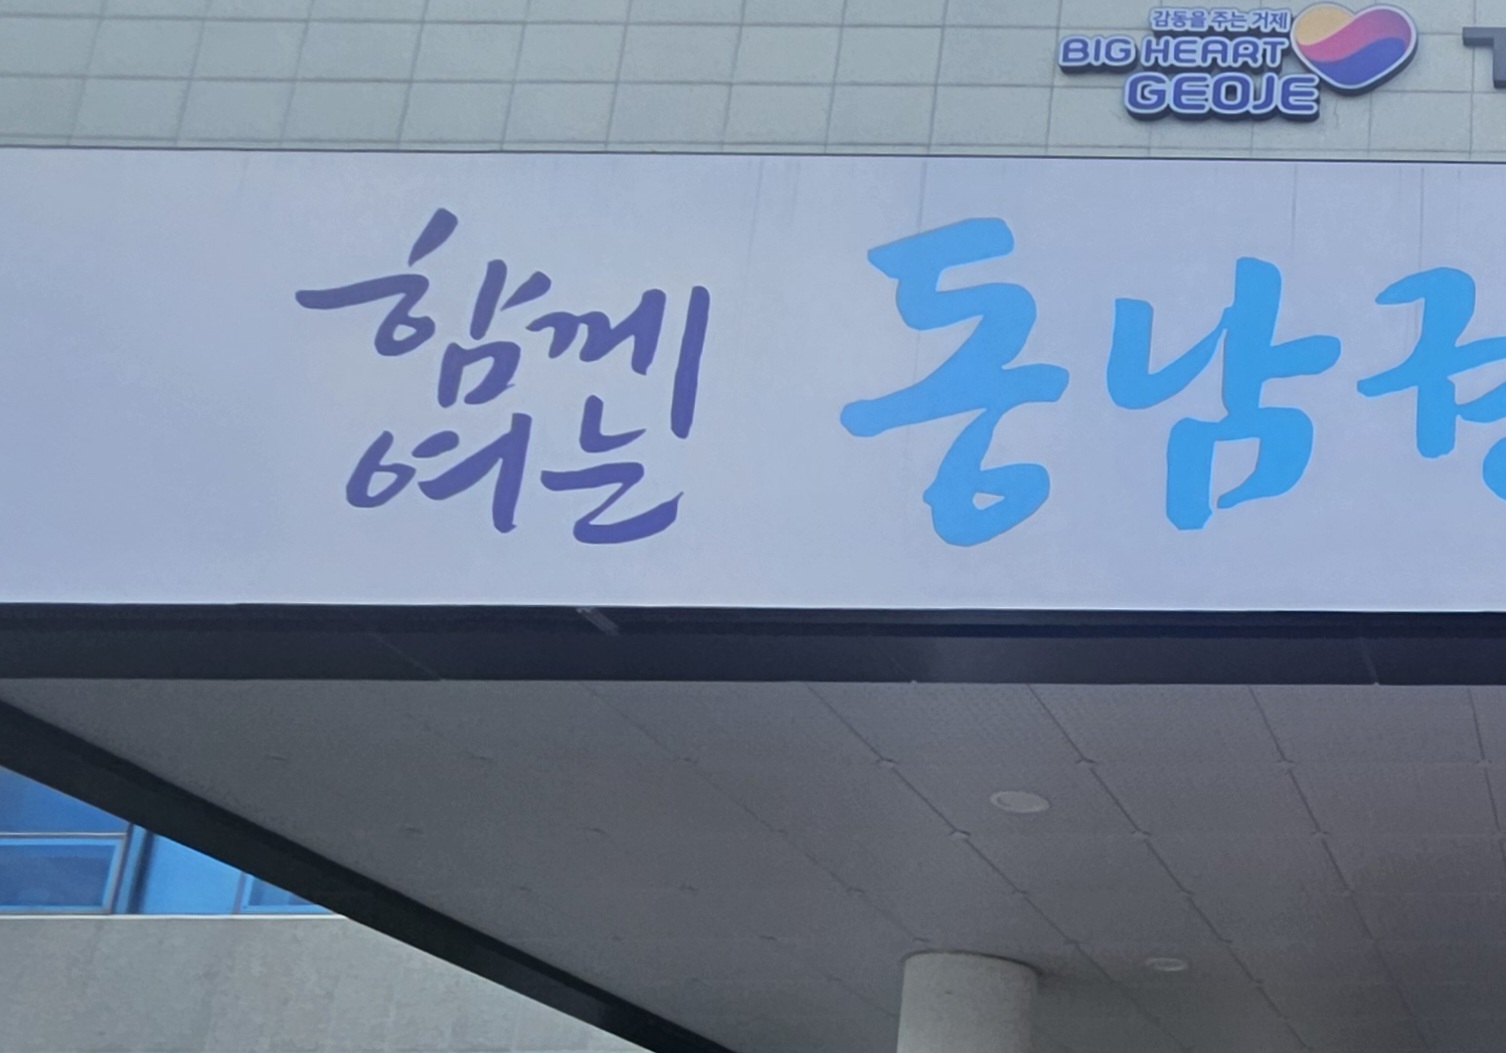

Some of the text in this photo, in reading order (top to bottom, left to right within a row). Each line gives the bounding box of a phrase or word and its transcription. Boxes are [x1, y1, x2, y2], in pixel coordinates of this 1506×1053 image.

[1153, 10, 1289, 30] 감동을 주는 거제
[1061, 37, 1286, 65] BIG HEART
[1126, 73, 1318, 113] GEOJE
[296, 208, 710, 438] 함께
[346, 395, 684, 545] 여는
